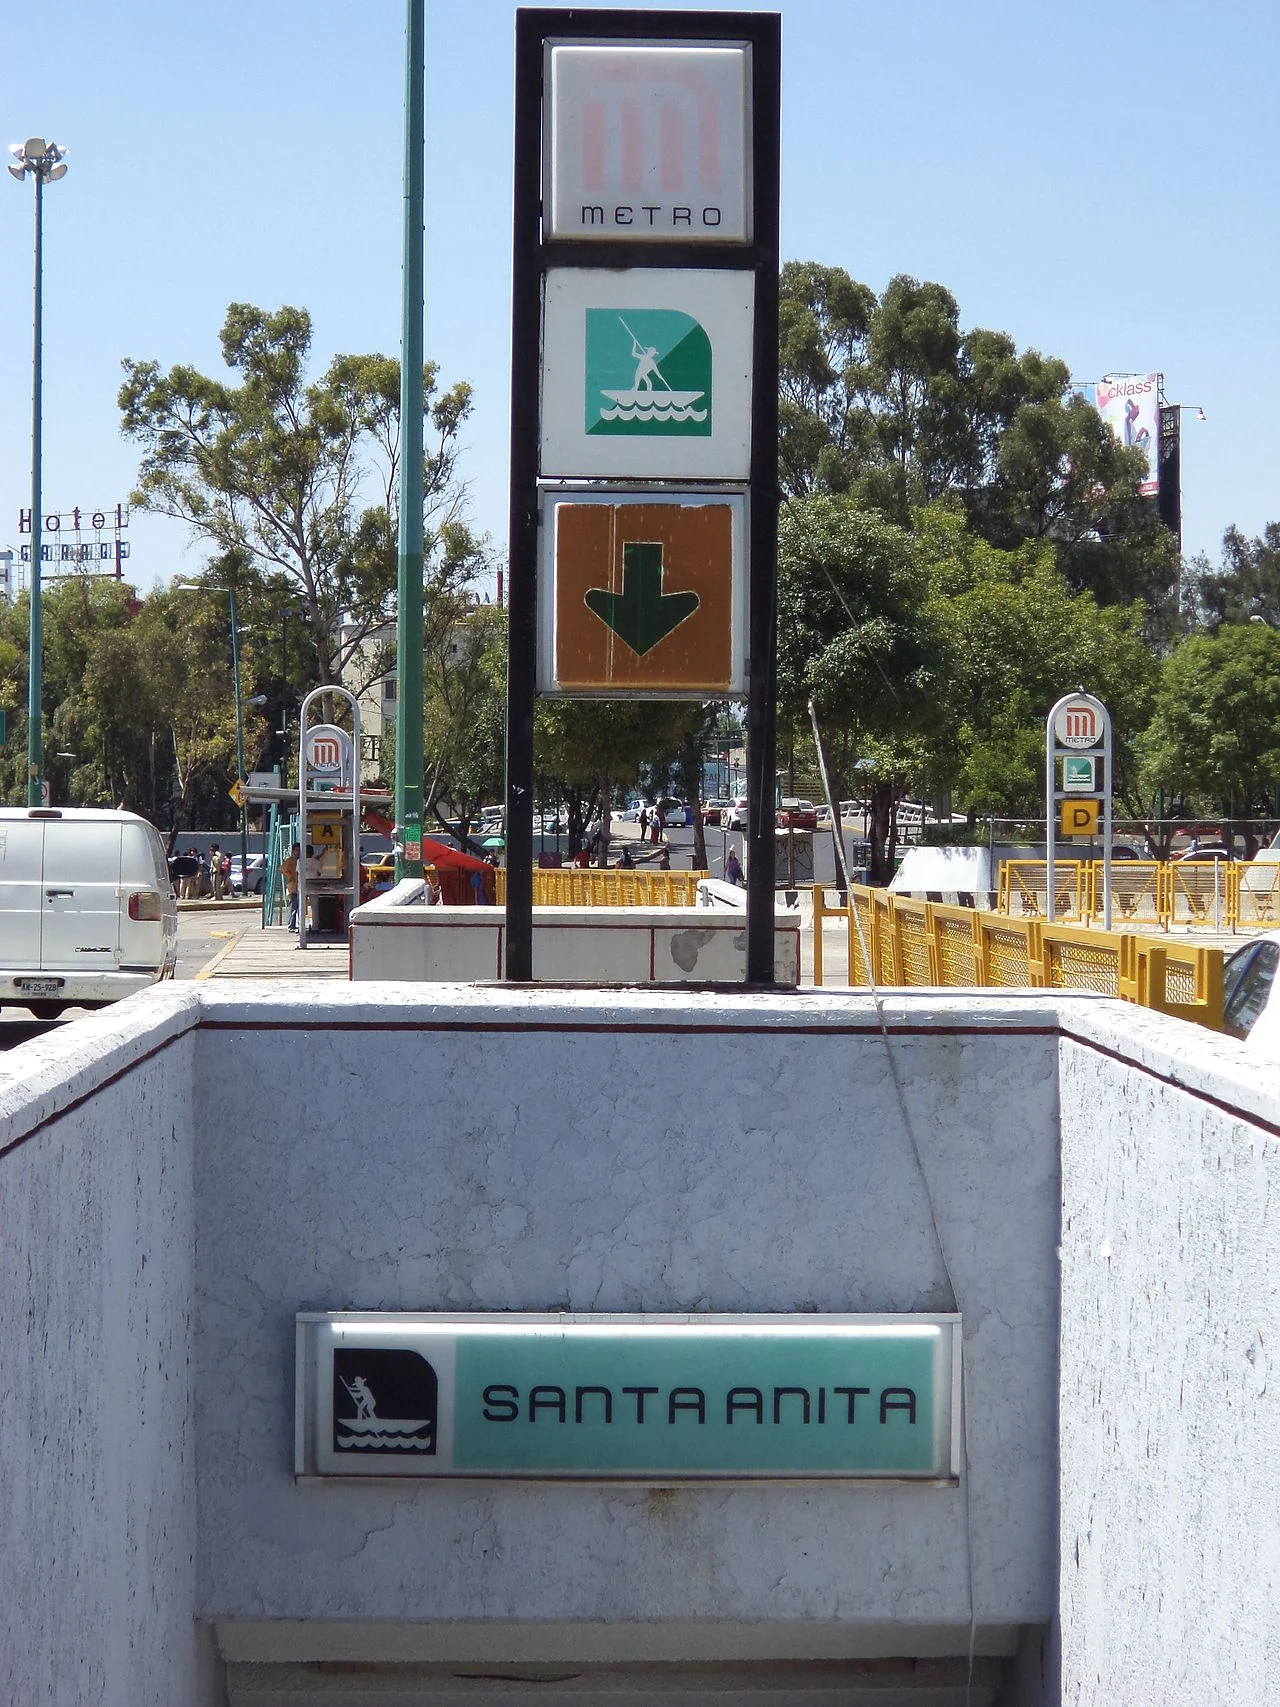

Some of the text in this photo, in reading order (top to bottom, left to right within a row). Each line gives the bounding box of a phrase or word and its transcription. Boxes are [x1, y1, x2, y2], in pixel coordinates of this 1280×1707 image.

[581, 205, 722, 226] METRO
[1107, 380, 1153, 399] cklass
[1065, 736, 1096, 744] METRO
[1073, 808, 1091, 828] D
[321, 824, 334, 838] A
[482, 1384, 917, 1425] SANTA ANITA
